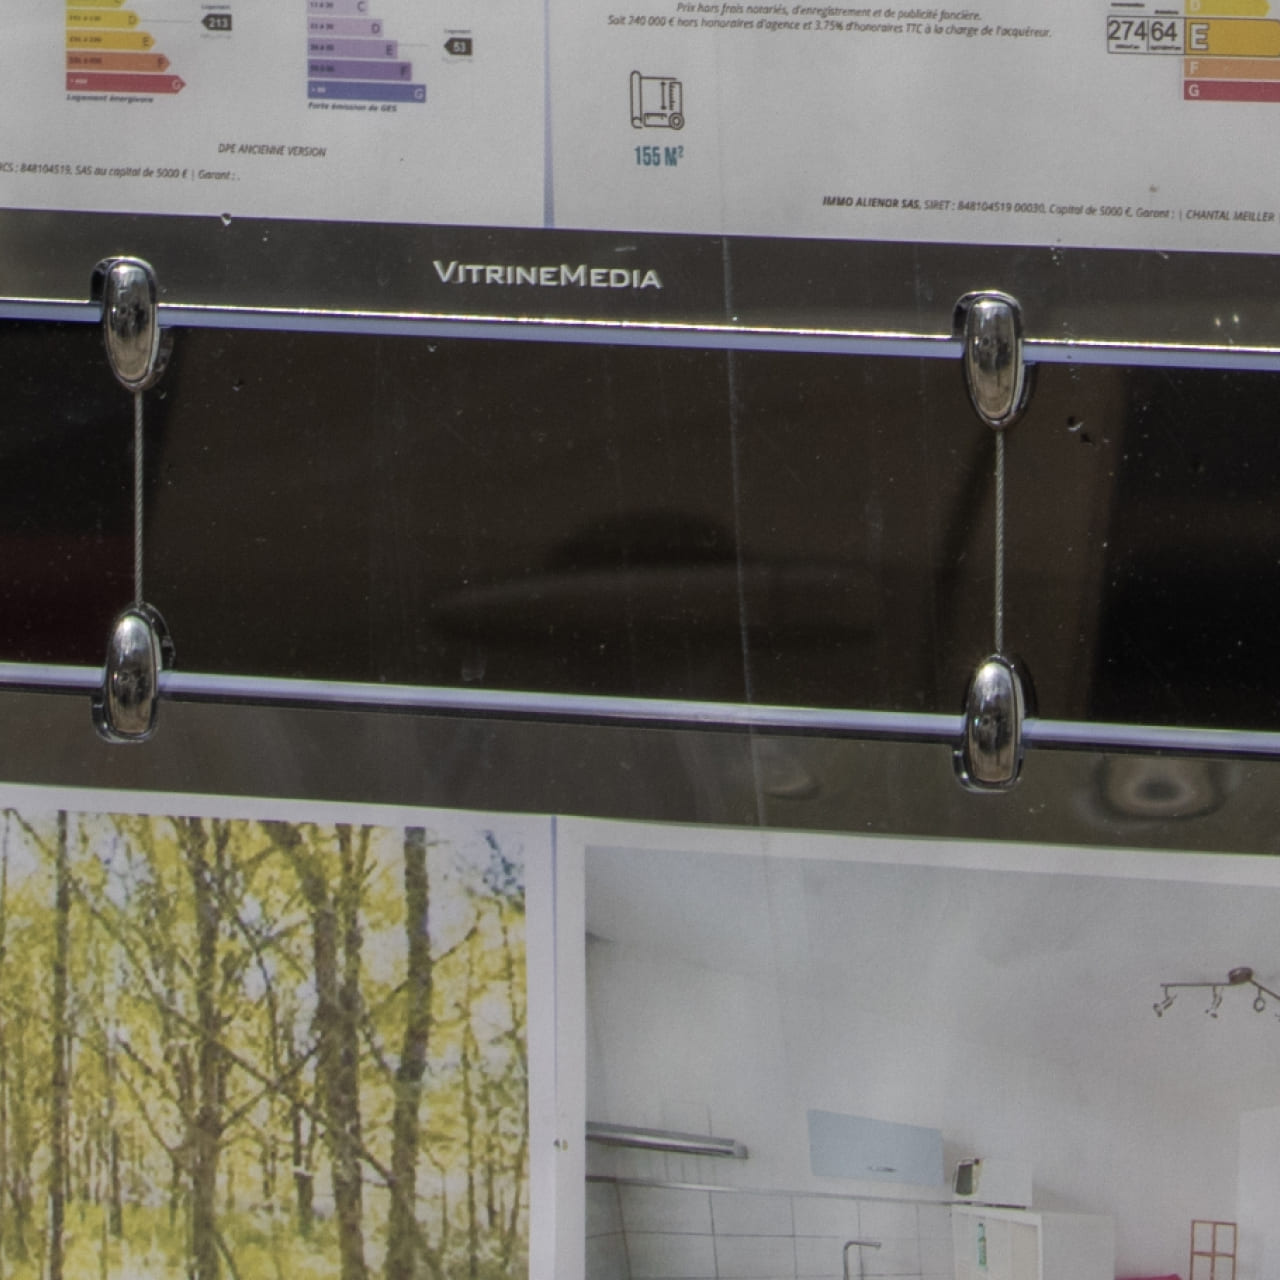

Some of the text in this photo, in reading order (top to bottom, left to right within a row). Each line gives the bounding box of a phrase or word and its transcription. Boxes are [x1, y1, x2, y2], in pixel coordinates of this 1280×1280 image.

[1107, 19, 1147, 42] 274
[1150, 20, 1178, 43] 64
[217, 142, 328, 158] DPE ANCIENNE VERSION
